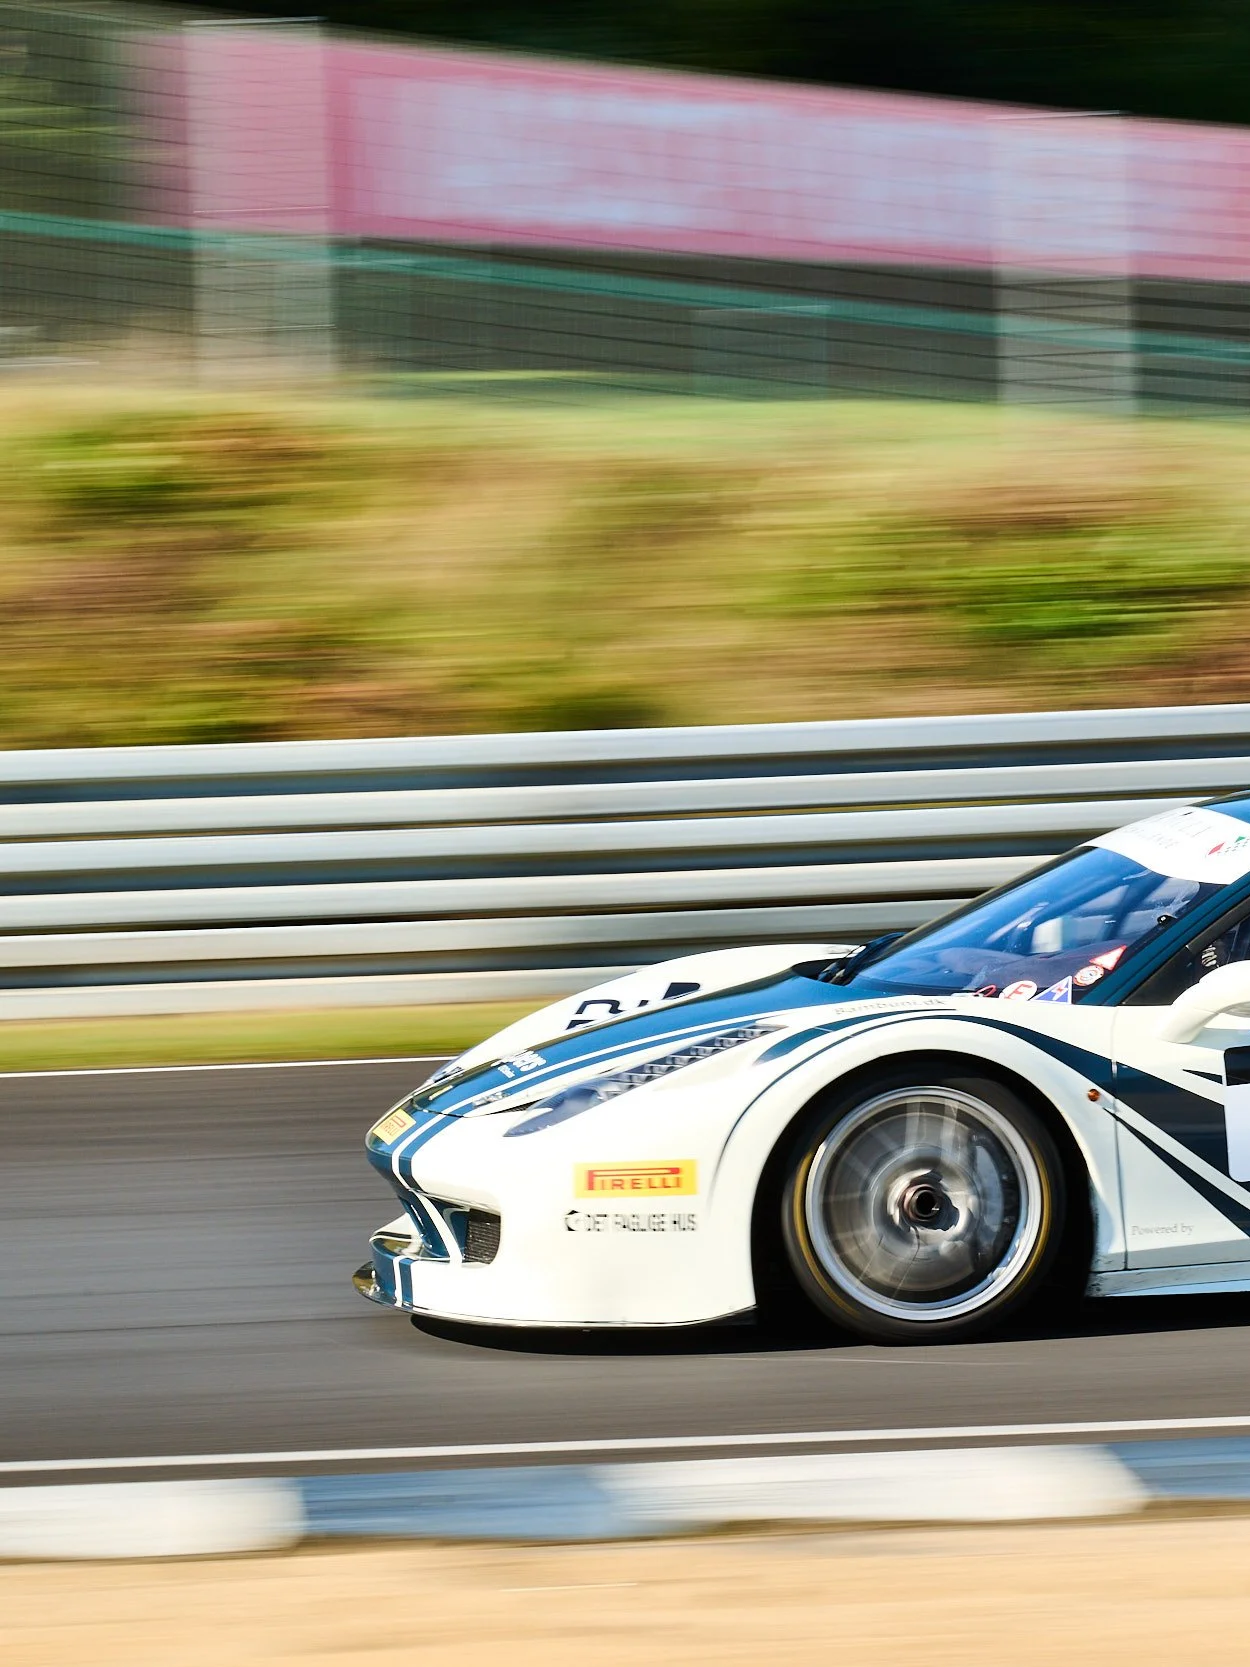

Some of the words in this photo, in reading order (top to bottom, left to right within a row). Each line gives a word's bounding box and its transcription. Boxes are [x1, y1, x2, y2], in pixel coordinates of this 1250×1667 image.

[586, 1167, 682, 1190] PIRELLI
[1131, 1223, 1178, 1236] Powered
[1180, 1222, 1194, 1235] by
